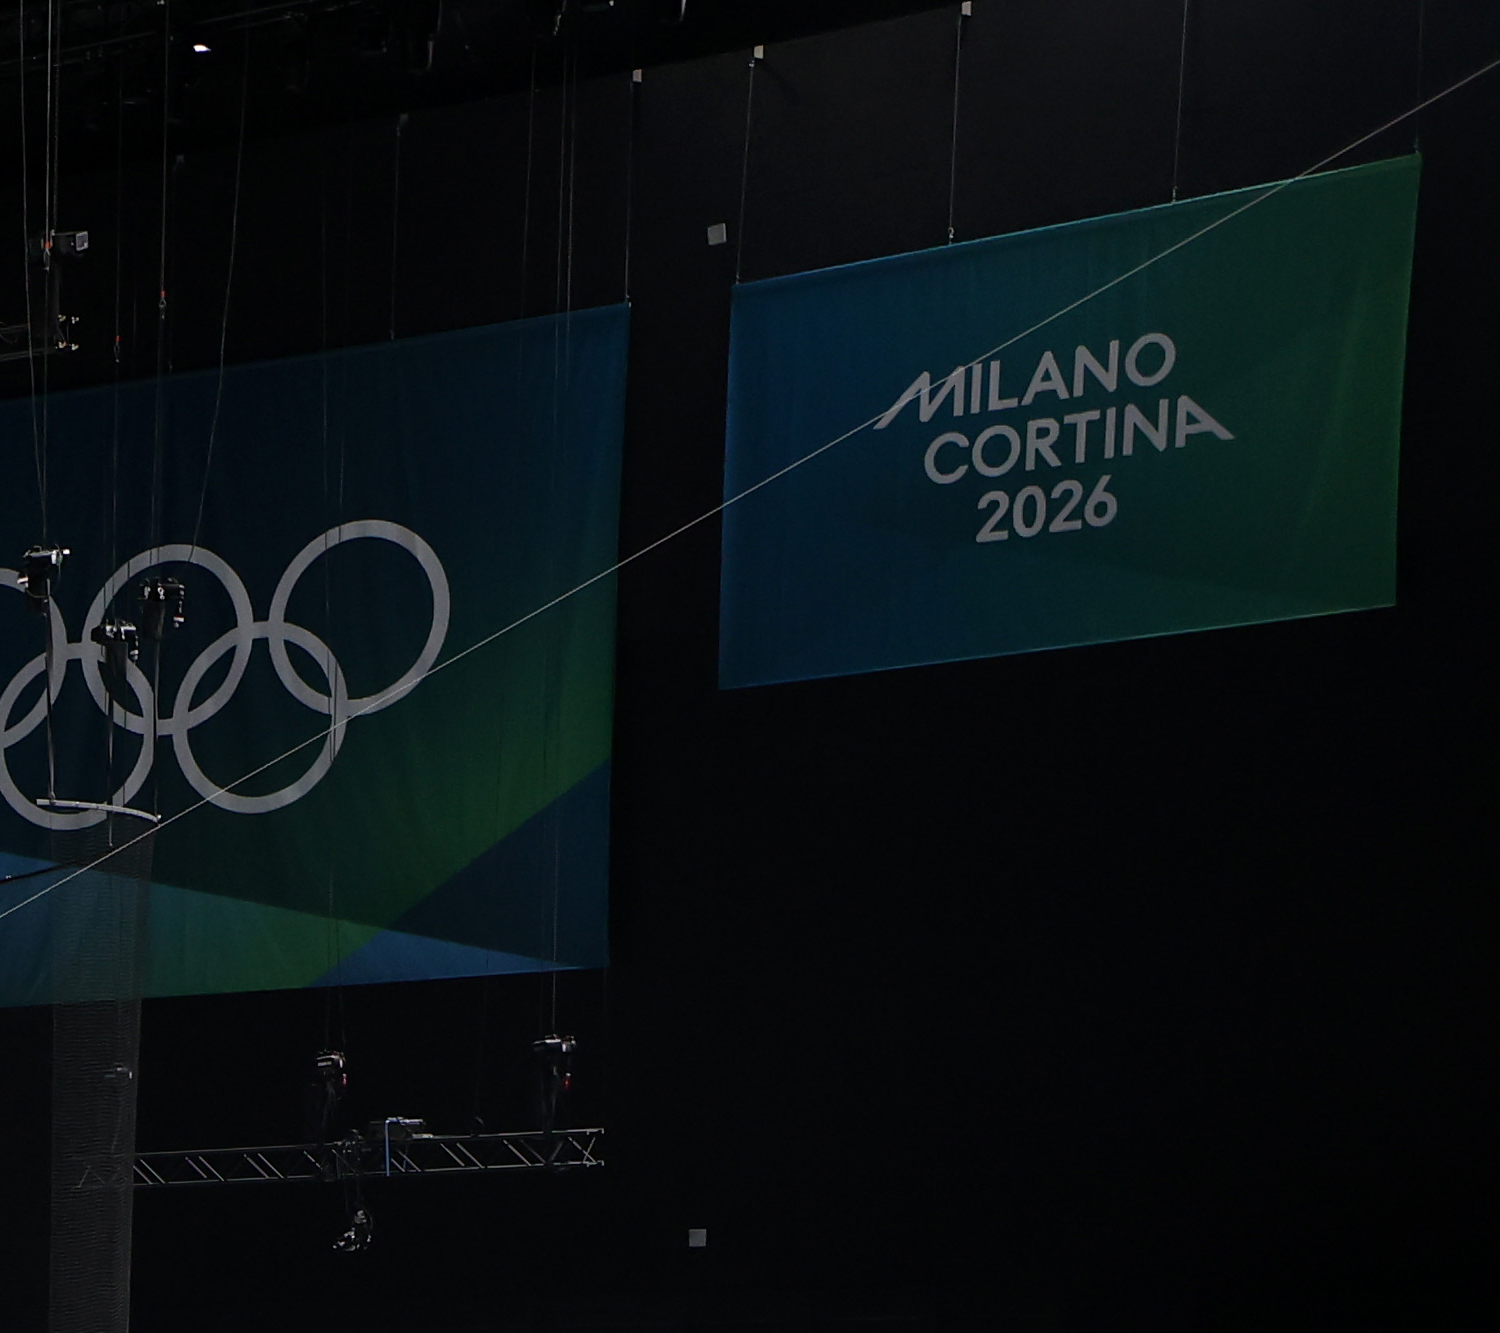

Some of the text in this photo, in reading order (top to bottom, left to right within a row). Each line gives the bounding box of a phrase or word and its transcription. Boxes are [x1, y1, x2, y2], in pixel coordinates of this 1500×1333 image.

[873, 332, 1176, 430] MILANO
[924, 395, 1236, 485] CORTINA
[975, 474, 1118, 543] 2026
